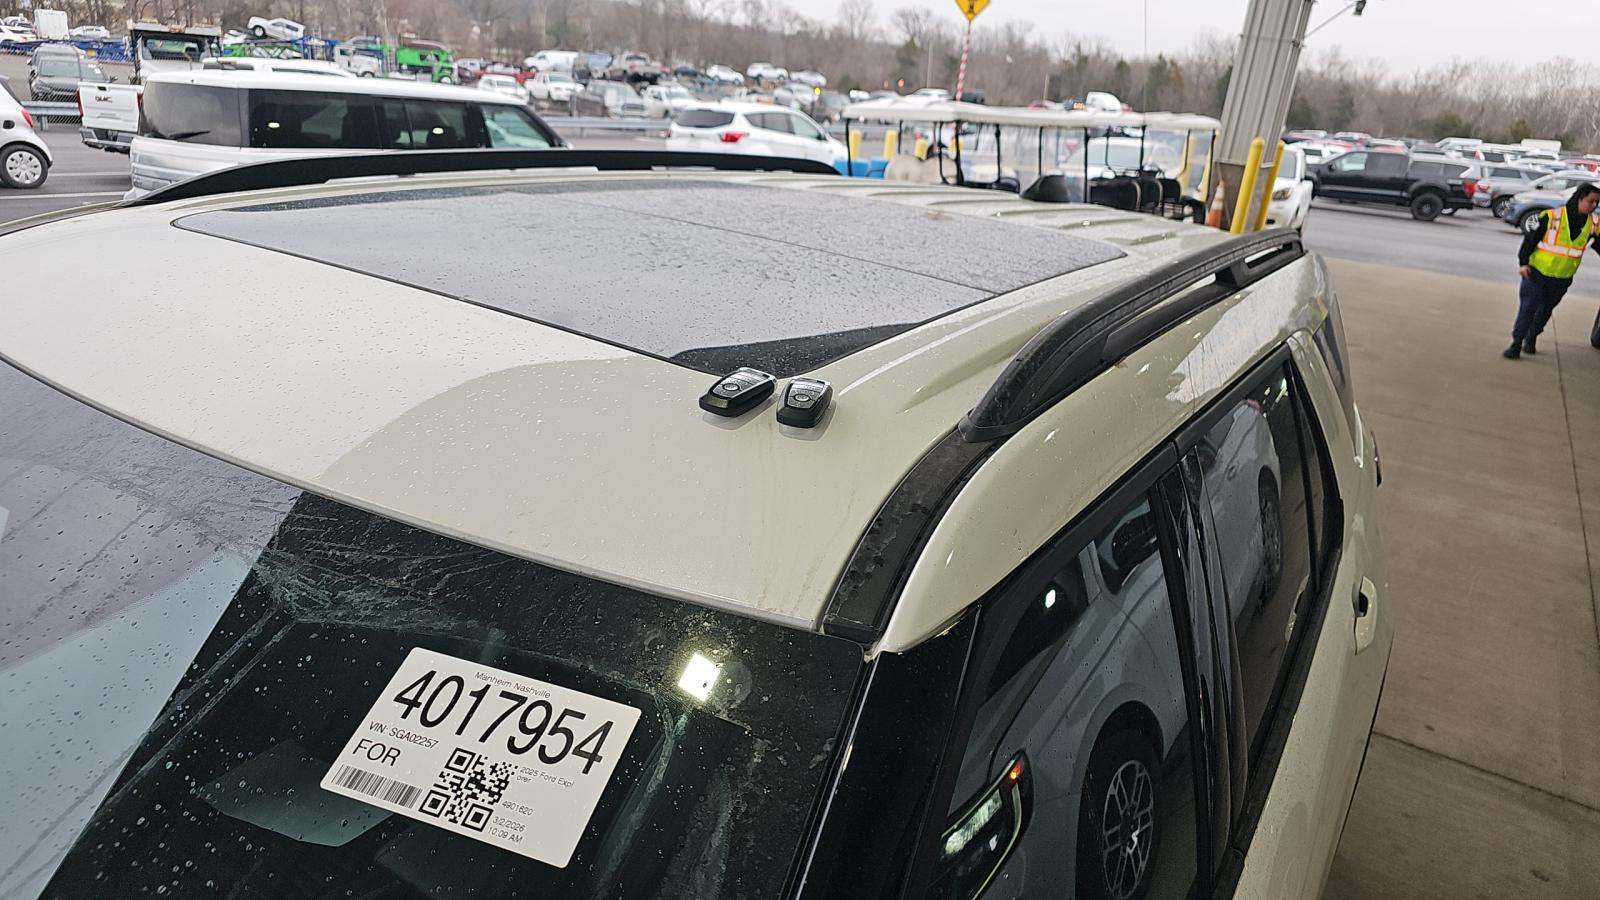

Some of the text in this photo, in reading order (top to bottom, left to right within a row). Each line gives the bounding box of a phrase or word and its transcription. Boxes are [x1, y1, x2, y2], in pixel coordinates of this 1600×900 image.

[474, 671, 551, 699] Manheim Nashville
[393, 670, 614, 775] 4017954
[369, 721, 439, 749] VIN: SGA02257
[352, 738, 401, 767] FOR
[520, 767, 539, 777] 2025
[540, 771, 558, 783] Ford
[502, 800, 533, 816] 4901620
[488, 826, 523, 844] 10:09 AM
[492, 816, 526, 832] 3/2/2026
